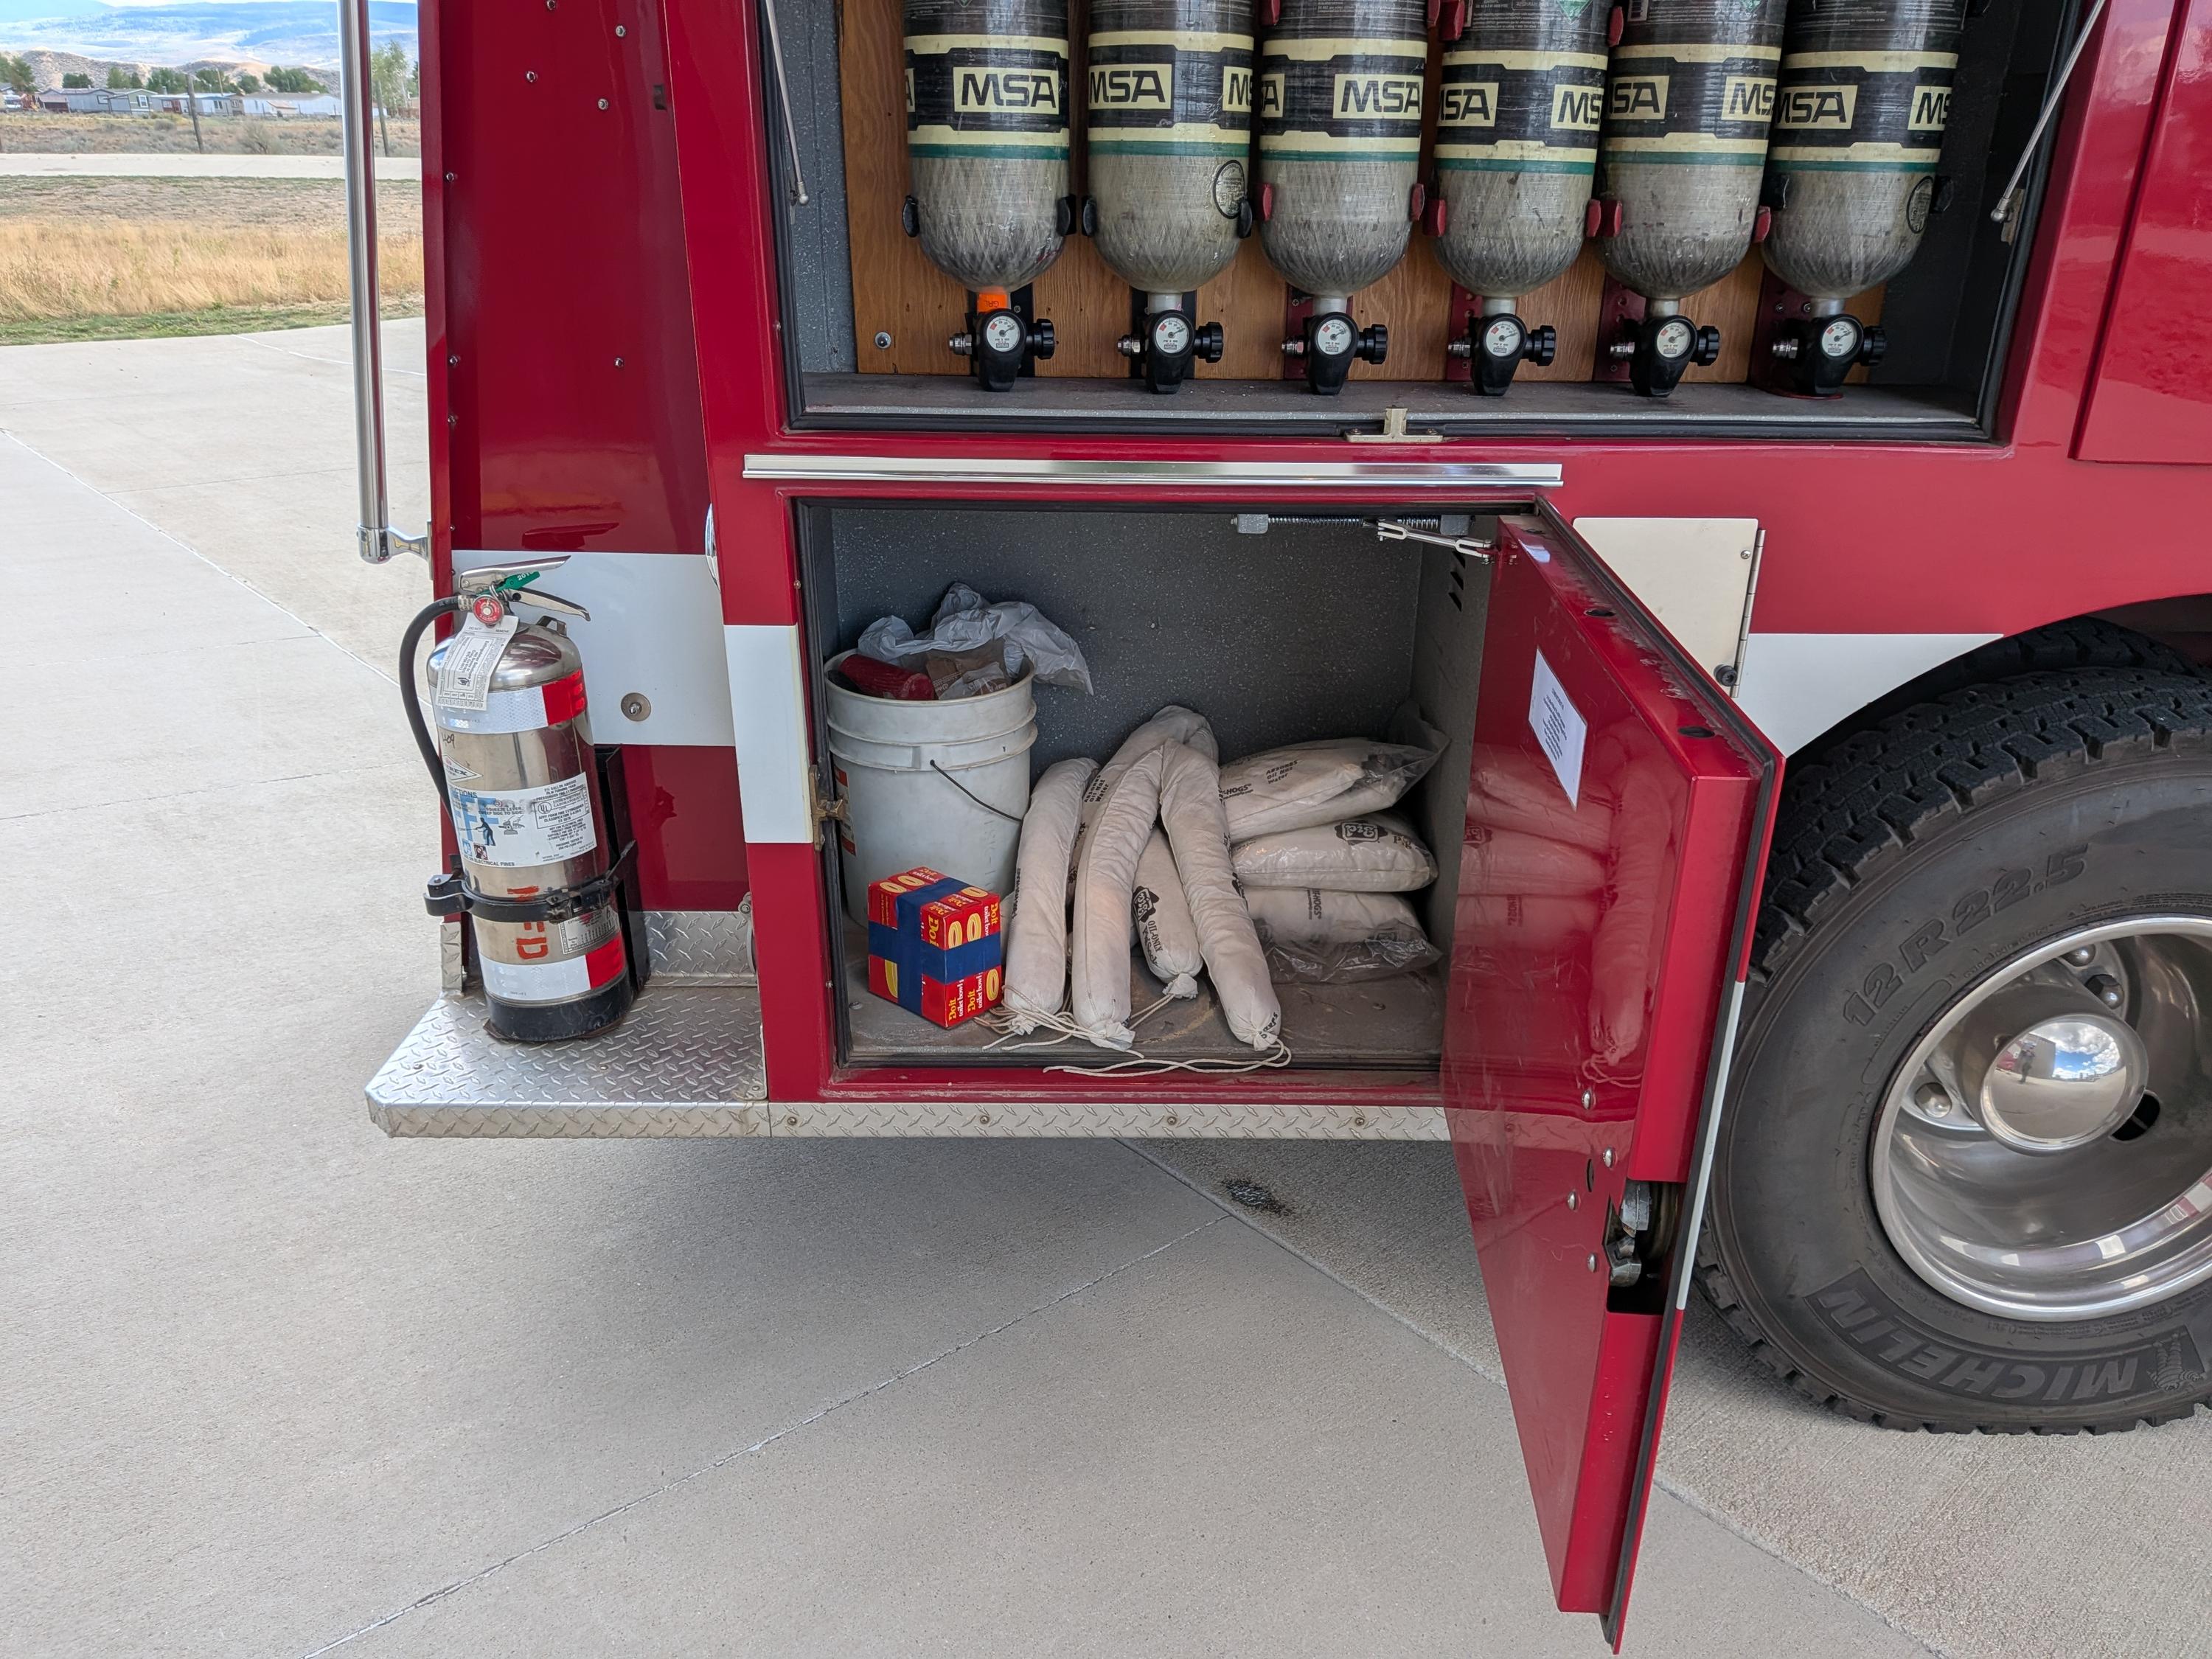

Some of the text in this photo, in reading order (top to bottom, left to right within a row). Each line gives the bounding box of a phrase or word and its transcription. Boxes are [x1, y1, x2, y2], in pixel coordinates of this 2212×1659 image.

[961, 73, 1057, 108] MSA
[1090, 70, 1166, 103] MSA
[1340, 80, 1421, 114] MSA
[1610, 82, 1660, 114] SA
[1729, 83, 1774, 116] MS
[1440, 88, 1491, 121] SA
[1557, 90, 1603, 124] MS
[1147, 919, 1164, 952] OIL-ONLY
[956, 983, 964, 1001] bowl
[975, 975, 984, 1009] toilet bowl
[1816, 1288, 2139, 1401] MICHELIN
